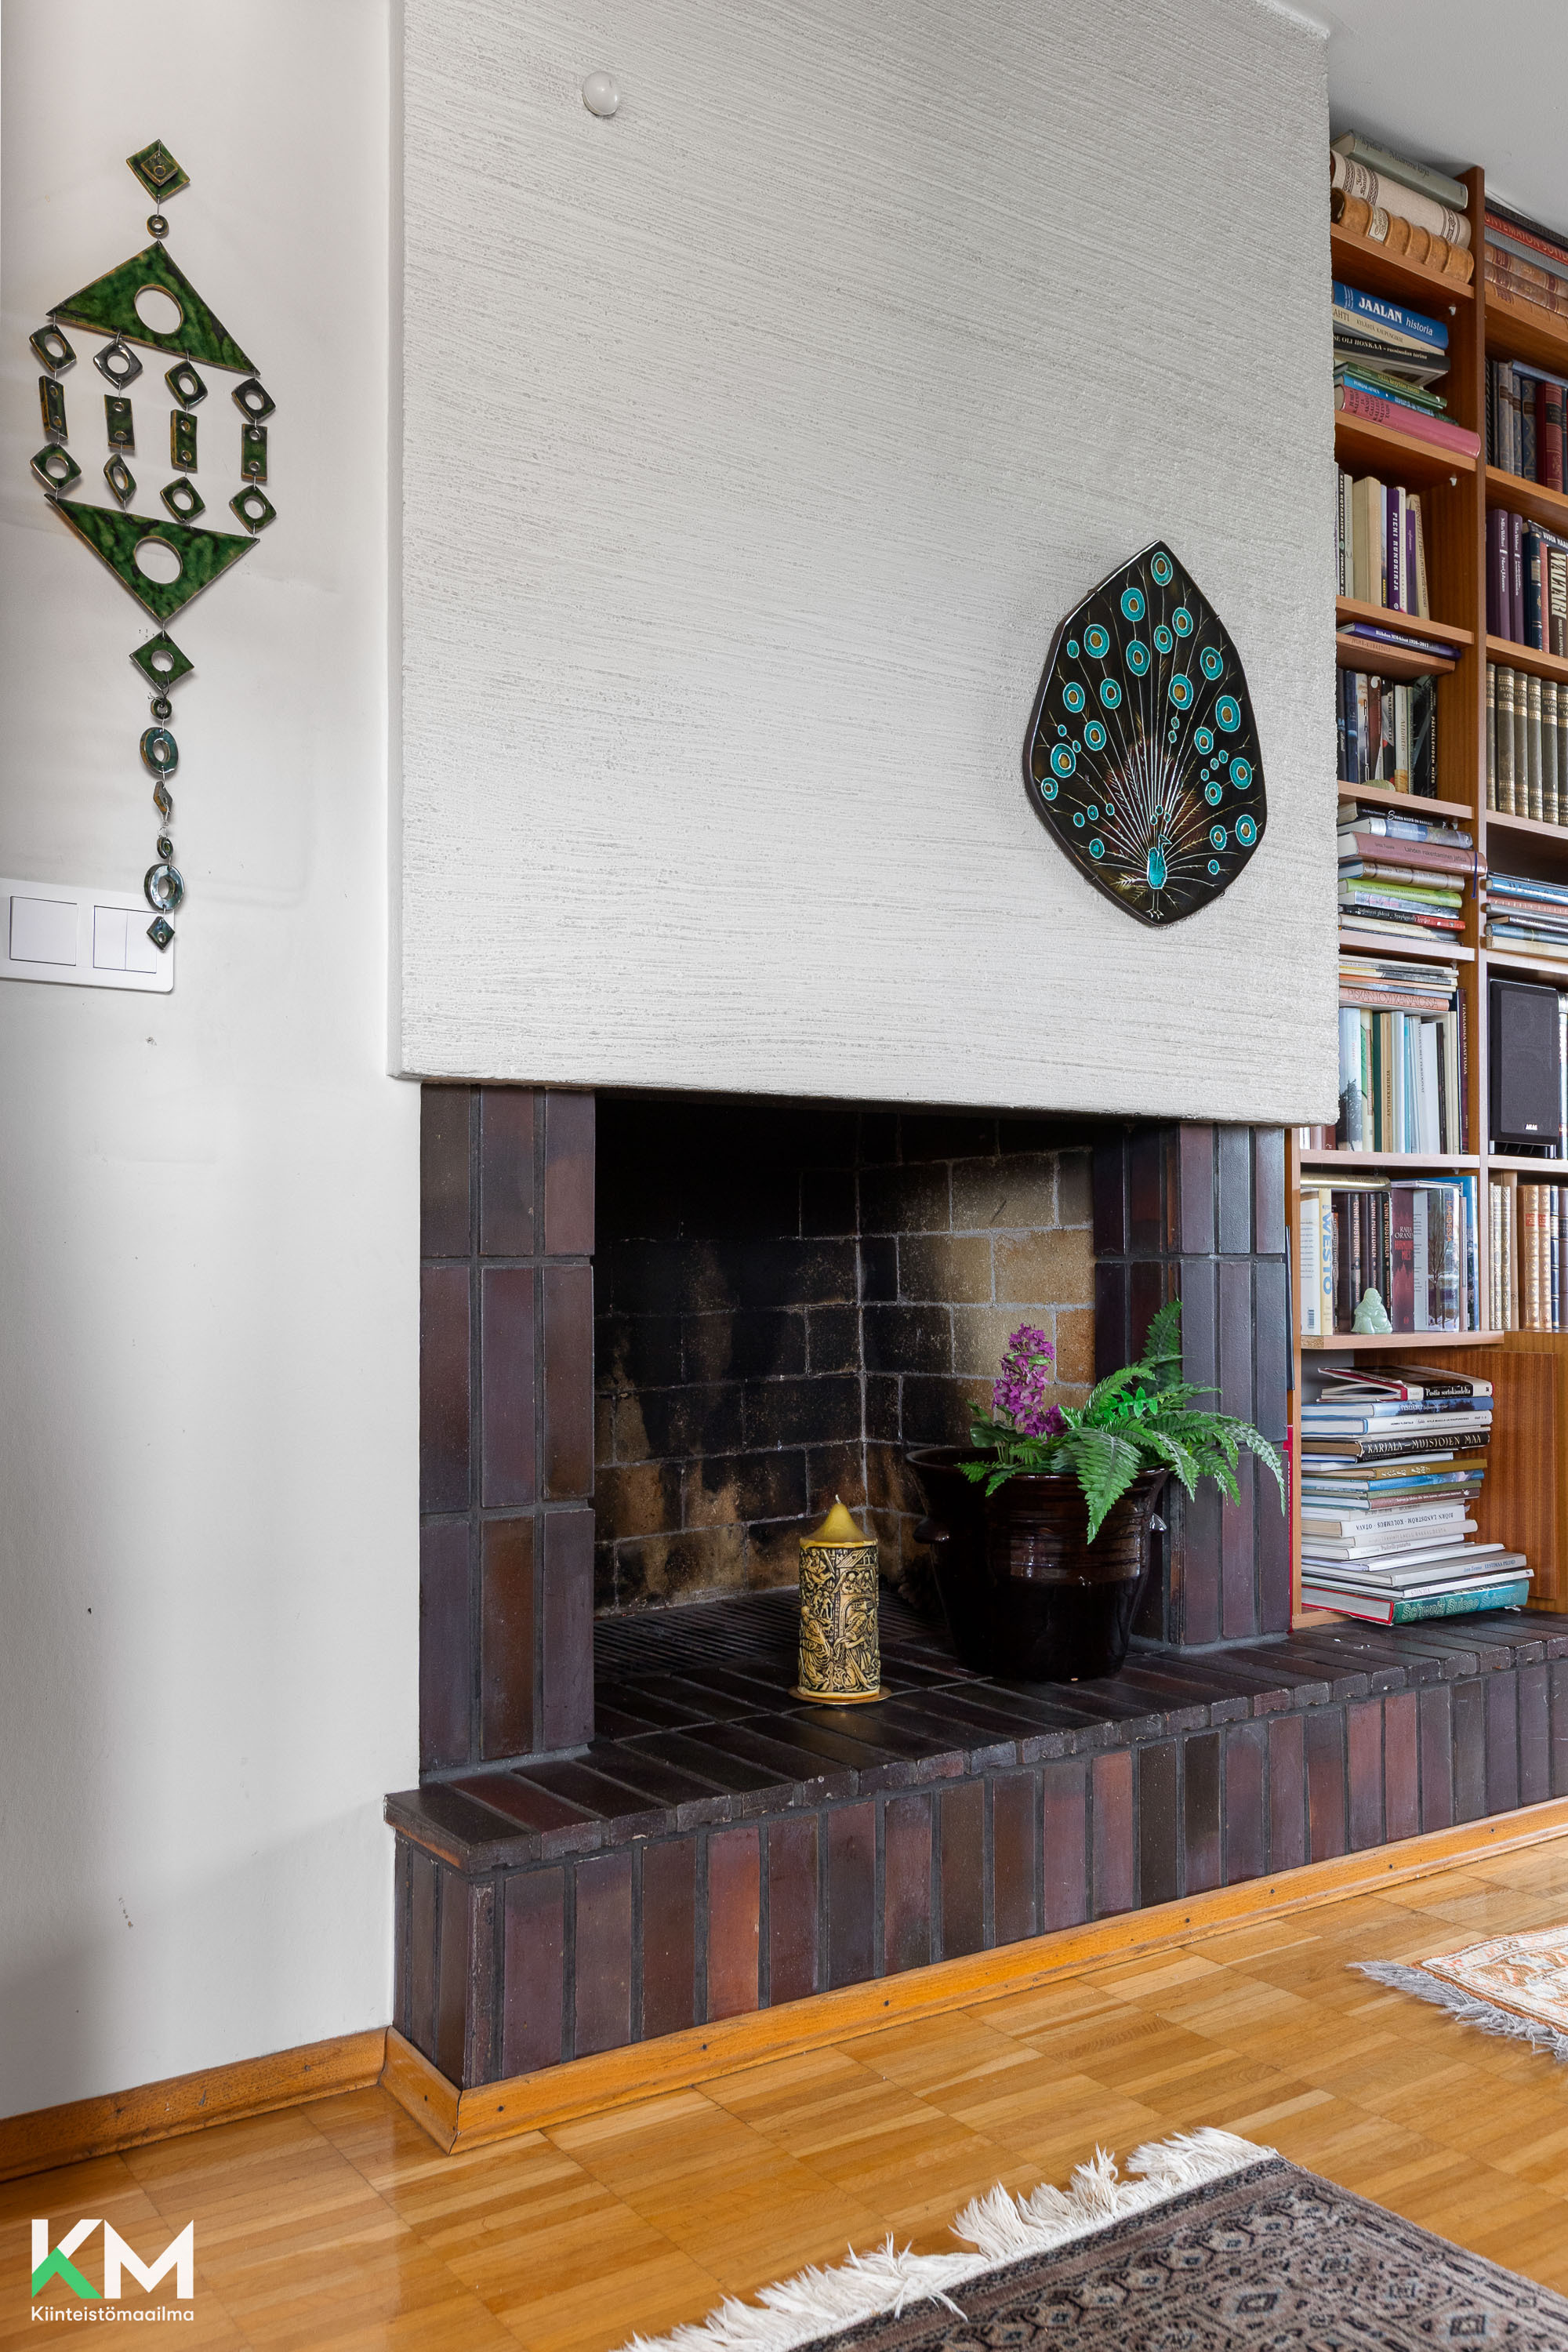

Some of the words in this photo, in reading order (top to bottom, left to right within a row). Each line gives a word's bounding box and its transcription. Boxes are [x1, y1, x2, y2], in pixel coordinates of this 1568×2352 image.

[1485, 212, 1540, 248] UNTEMATON
[1334, 308, 1349, 322] AHTI
[1359, 296, 1402, 324] JAALAN
[1406, 318, 1433, 336] historia
[1354, 338, 1382, 350] HONKAA
[1550, 552, 1566, 620] WALTARI
[1404, 846, 1421, 855] Lahden
[1422, 850, 1453, 860] rakentaminen
[1394, 994, 1438, 1008] KAINALOSSA
[1425, 1387, 1440, 1396] Postia
[1441, 1386, 1471, 1396] sortokaudelta
[1367, 1442, 1403, 1454] KARJALA
[1411, 1436, 1460, 1450] MUISTOJEN
[1465, 1434, 1481, 1445] MAA
[1377, 1519, 1404, 1529] KOLUMBUS
[1407, 1514, 1438, 1523] LANDSTRÖM
[1402, 1600, 1445, 1620] Schweiz
[1446, 1598, 1479, 1613] Suisse
[1480, 1590, 1519, 1608] Svizzera
